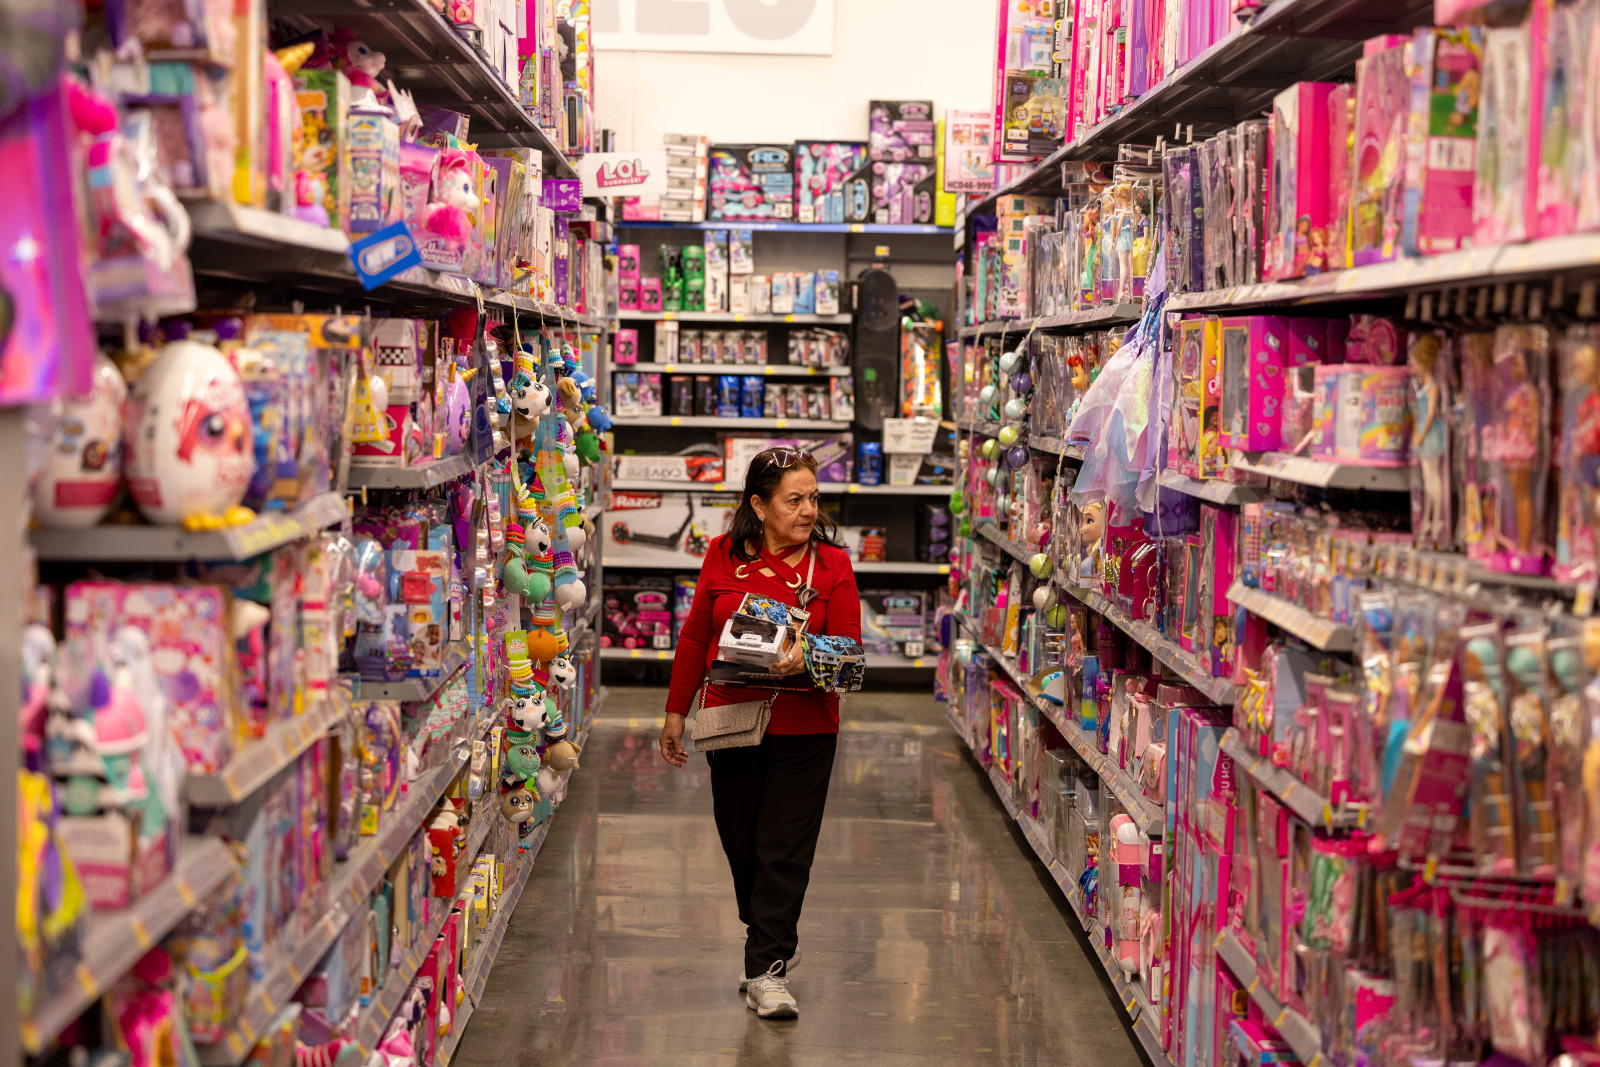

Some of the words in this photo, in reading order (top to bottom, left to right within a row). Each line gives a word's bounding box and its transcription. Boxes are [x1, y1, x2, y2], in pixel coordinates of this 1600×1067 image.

[602, 159, 649, 179] LOL
[603, 176, 642, 187] SURPRISE!
[616, 495, 661, 508] Razor
